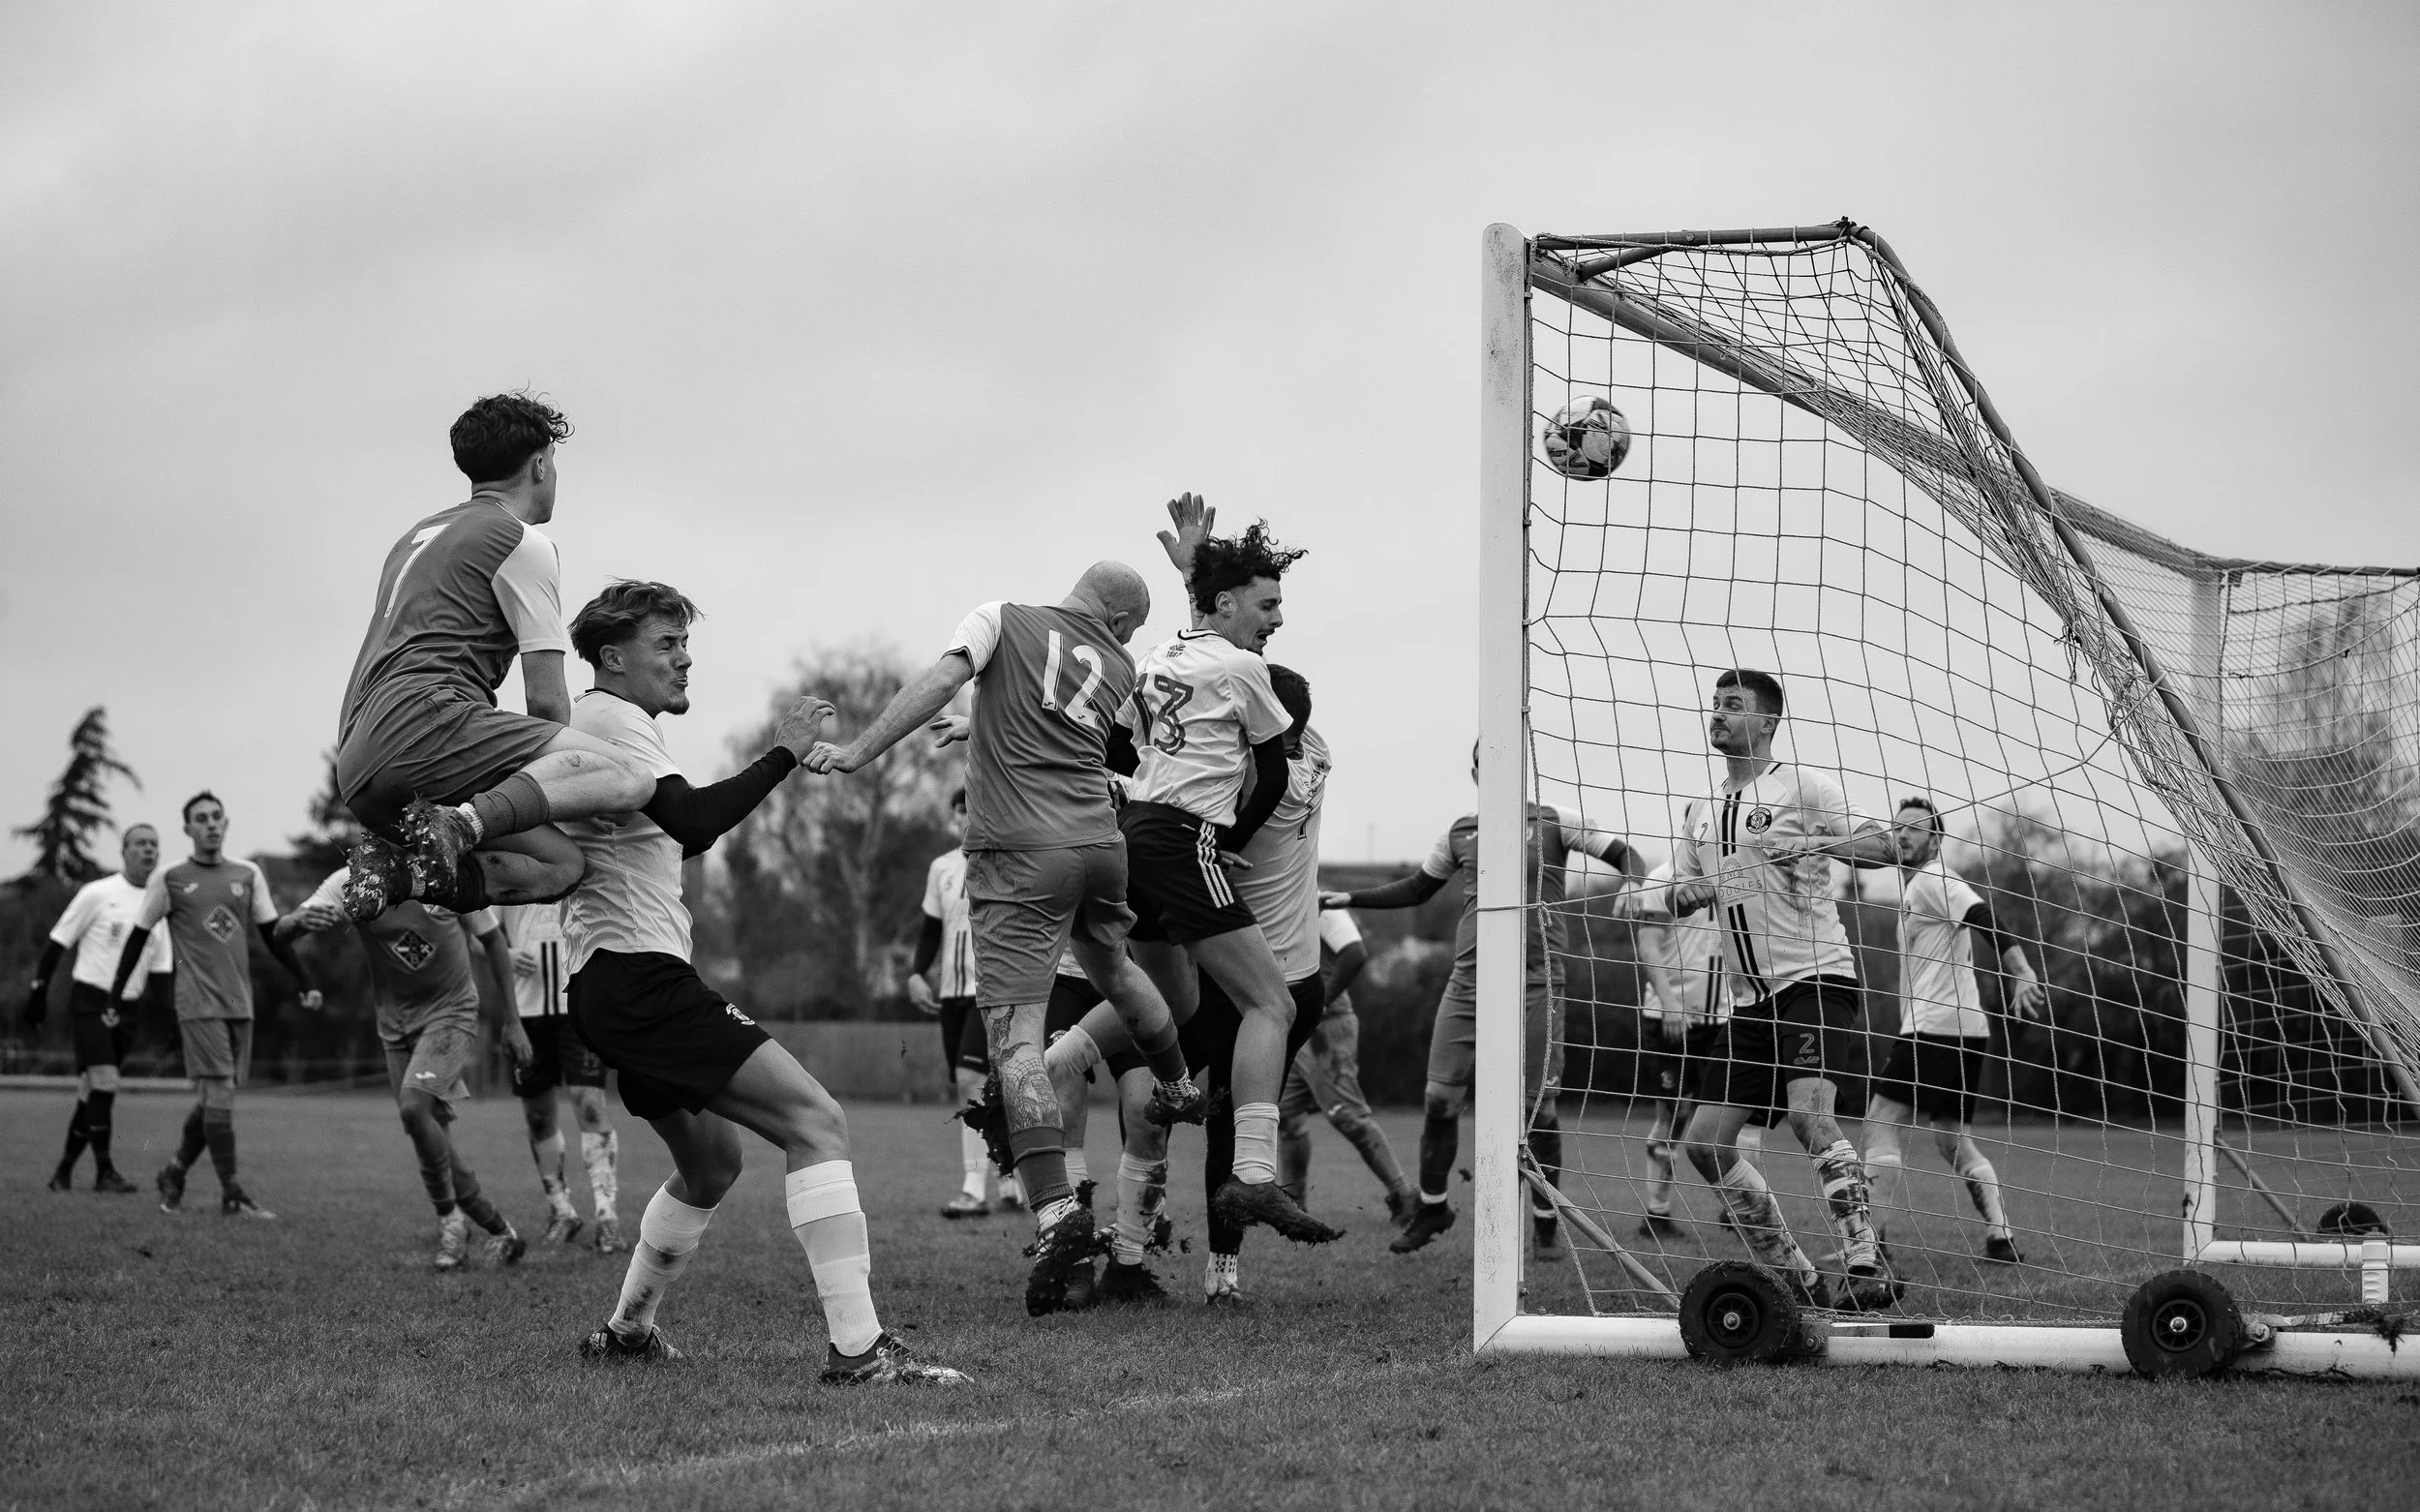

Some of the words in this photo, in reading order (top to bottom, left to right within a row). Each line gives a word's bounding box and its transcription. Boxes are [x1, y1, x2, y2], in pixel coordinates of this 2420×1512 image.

[383, 523, 451, 619] 7
[1042, 629, 1105, 729] 12
[1799, 1032, 1815, 1055] 2
